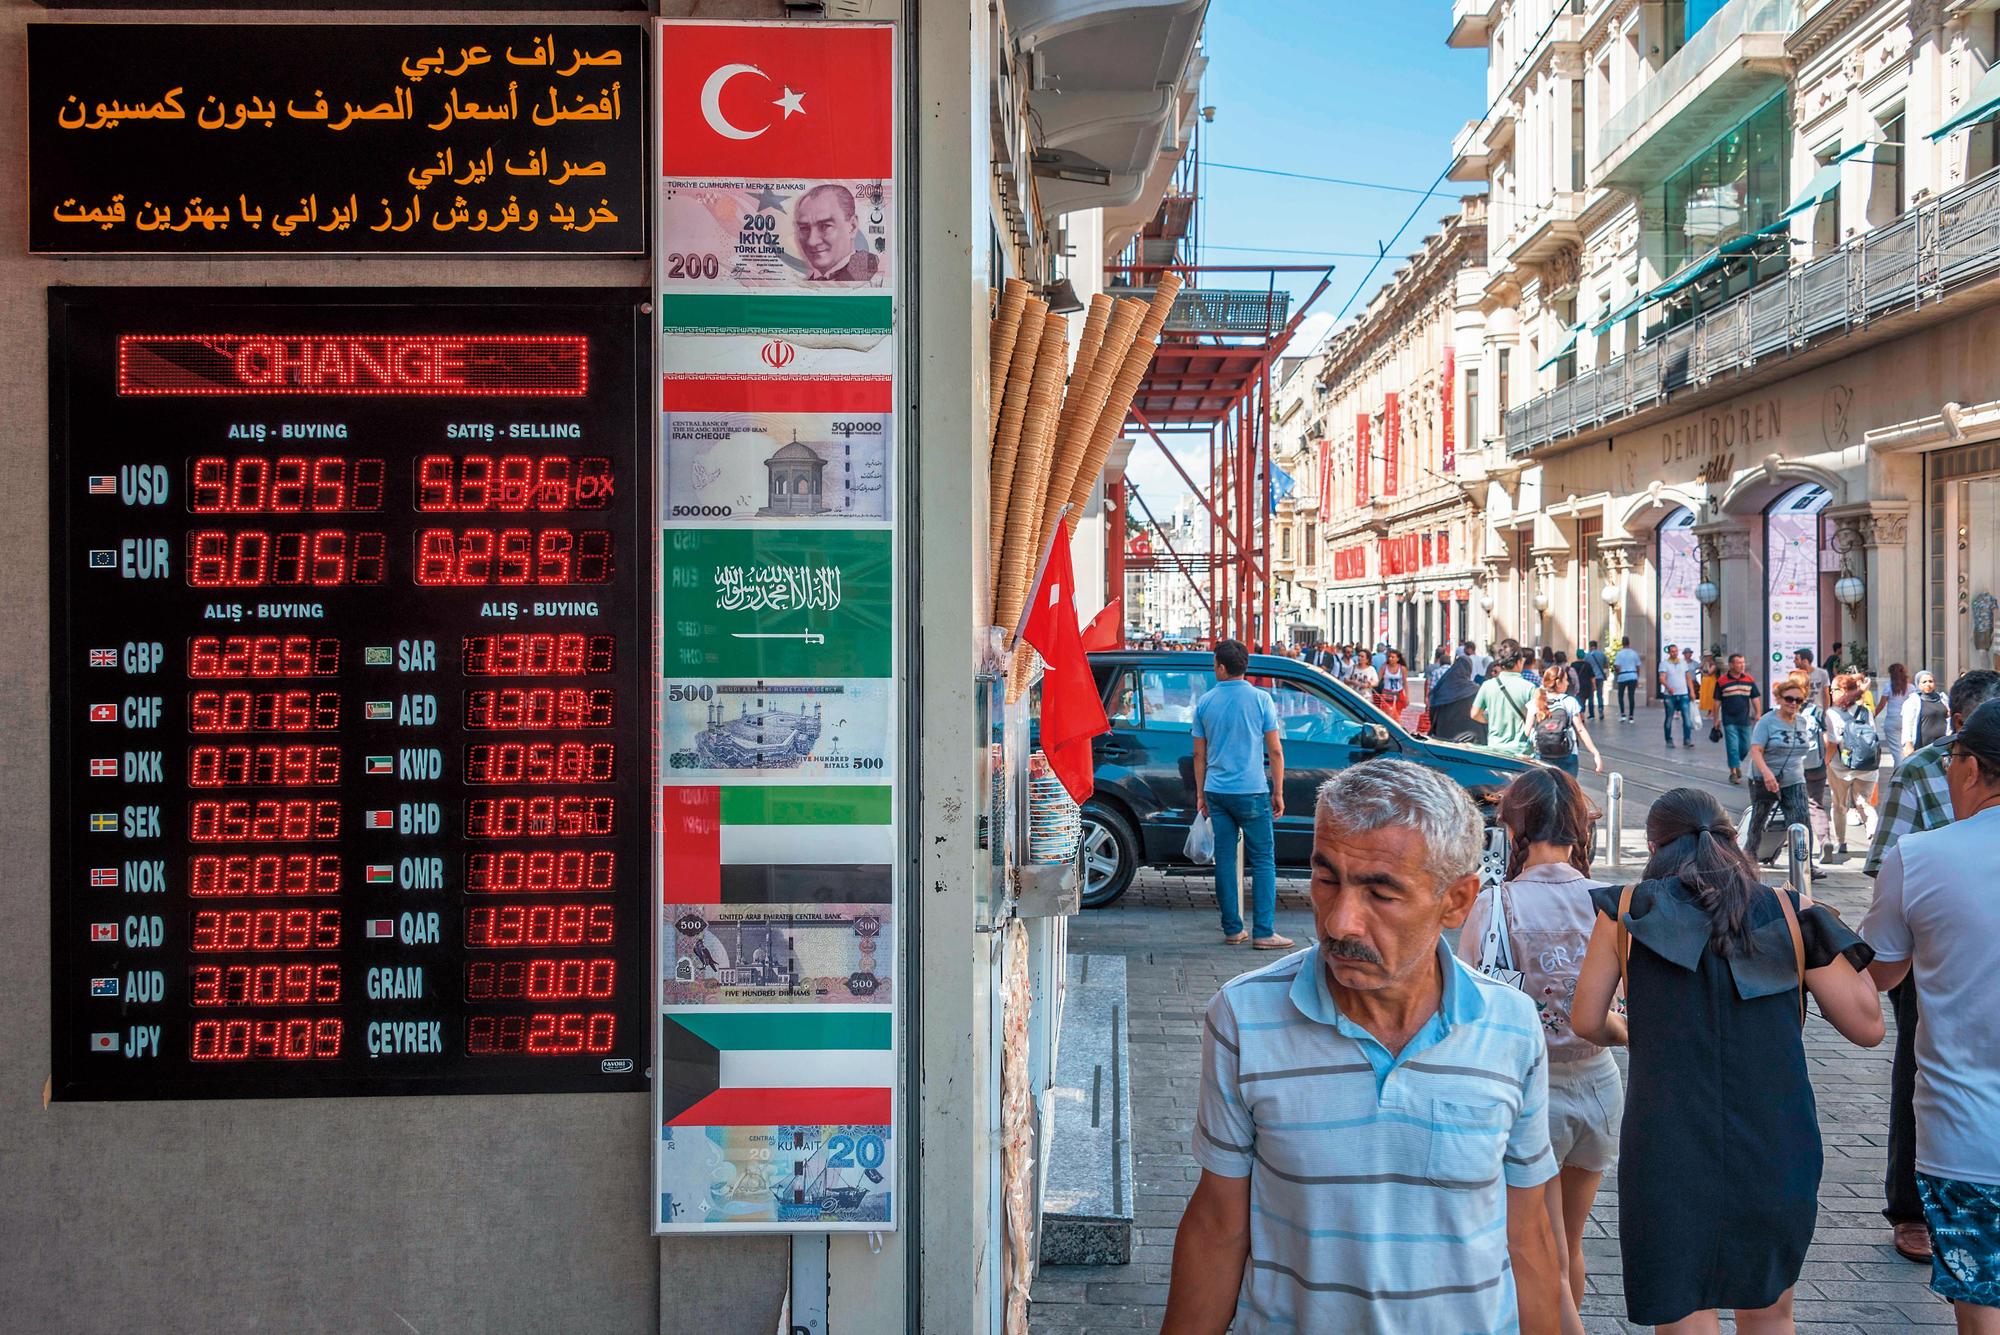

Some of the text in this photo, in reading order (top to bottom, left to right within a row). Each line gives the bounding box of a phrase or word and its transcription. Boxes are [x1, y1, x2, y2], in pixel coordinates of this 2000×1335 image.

[745, 182, 775, 190] MERKEZ
[776, 183, 806, 191] BANKASI
[739, 231, 780, 245] İKİYÜZ
[743, 214, 775, 231] 200
[668, 253, 719, 279] 200
[734, 245, 756, 254] TÜRK
[237, 343, 466, 384] CHANGE
[228, 423, 267, 443] ALIŞ
[281, 423, 348, 439] BUYING
[446, 423, 495, 442] SATIŞ
[508, 423, 581, 439] SELLING
[672, 432, 731, 440] IRAN CHEQUE
[121, 463, 169, 506] USD
[122, 537, 170, 580] EUR
[204, 603, 243, 623] ALIŞ
[257, 603, 324, 619] BUYING
[480, 602, 519, 621] ALIŞ
[533, 601, 599, 617] BUYING
[123, 641, 164, 674] GBP
[398, 639, 436, 672] SAR
[669, 684, 713, 701] 500
[123, 696, 163, 729] CHF
[398, 694, 437, 727] AED
[124, 750, 164, 783] DKK
[399, 747, 442, 781] KWD
[853, 757, 884, 769] 500
[123, 805, 161, 839] SEK
[399, 802, 441, 835] BHD
[124, 860, 166, 893] NOK
[399, 856, 444, 890] OMR
[124, 915, 164, 948] CAD
[399, 911, 440, 946] QAR
[680, 921, 701, 930] 500
[858, 922, 876, 930] 500
[124, 970, 165, 1004] AUD
[367, 966, 423, 1000] GRAM
[852, 979, 872, 989] 500
[125, 1025, 161, 1058] JPY
[367, 1020, 442, 1059] ÇEYREK
[750, 1148, 771, 1160] 20
[827, 1134, 885, 1169] 20
